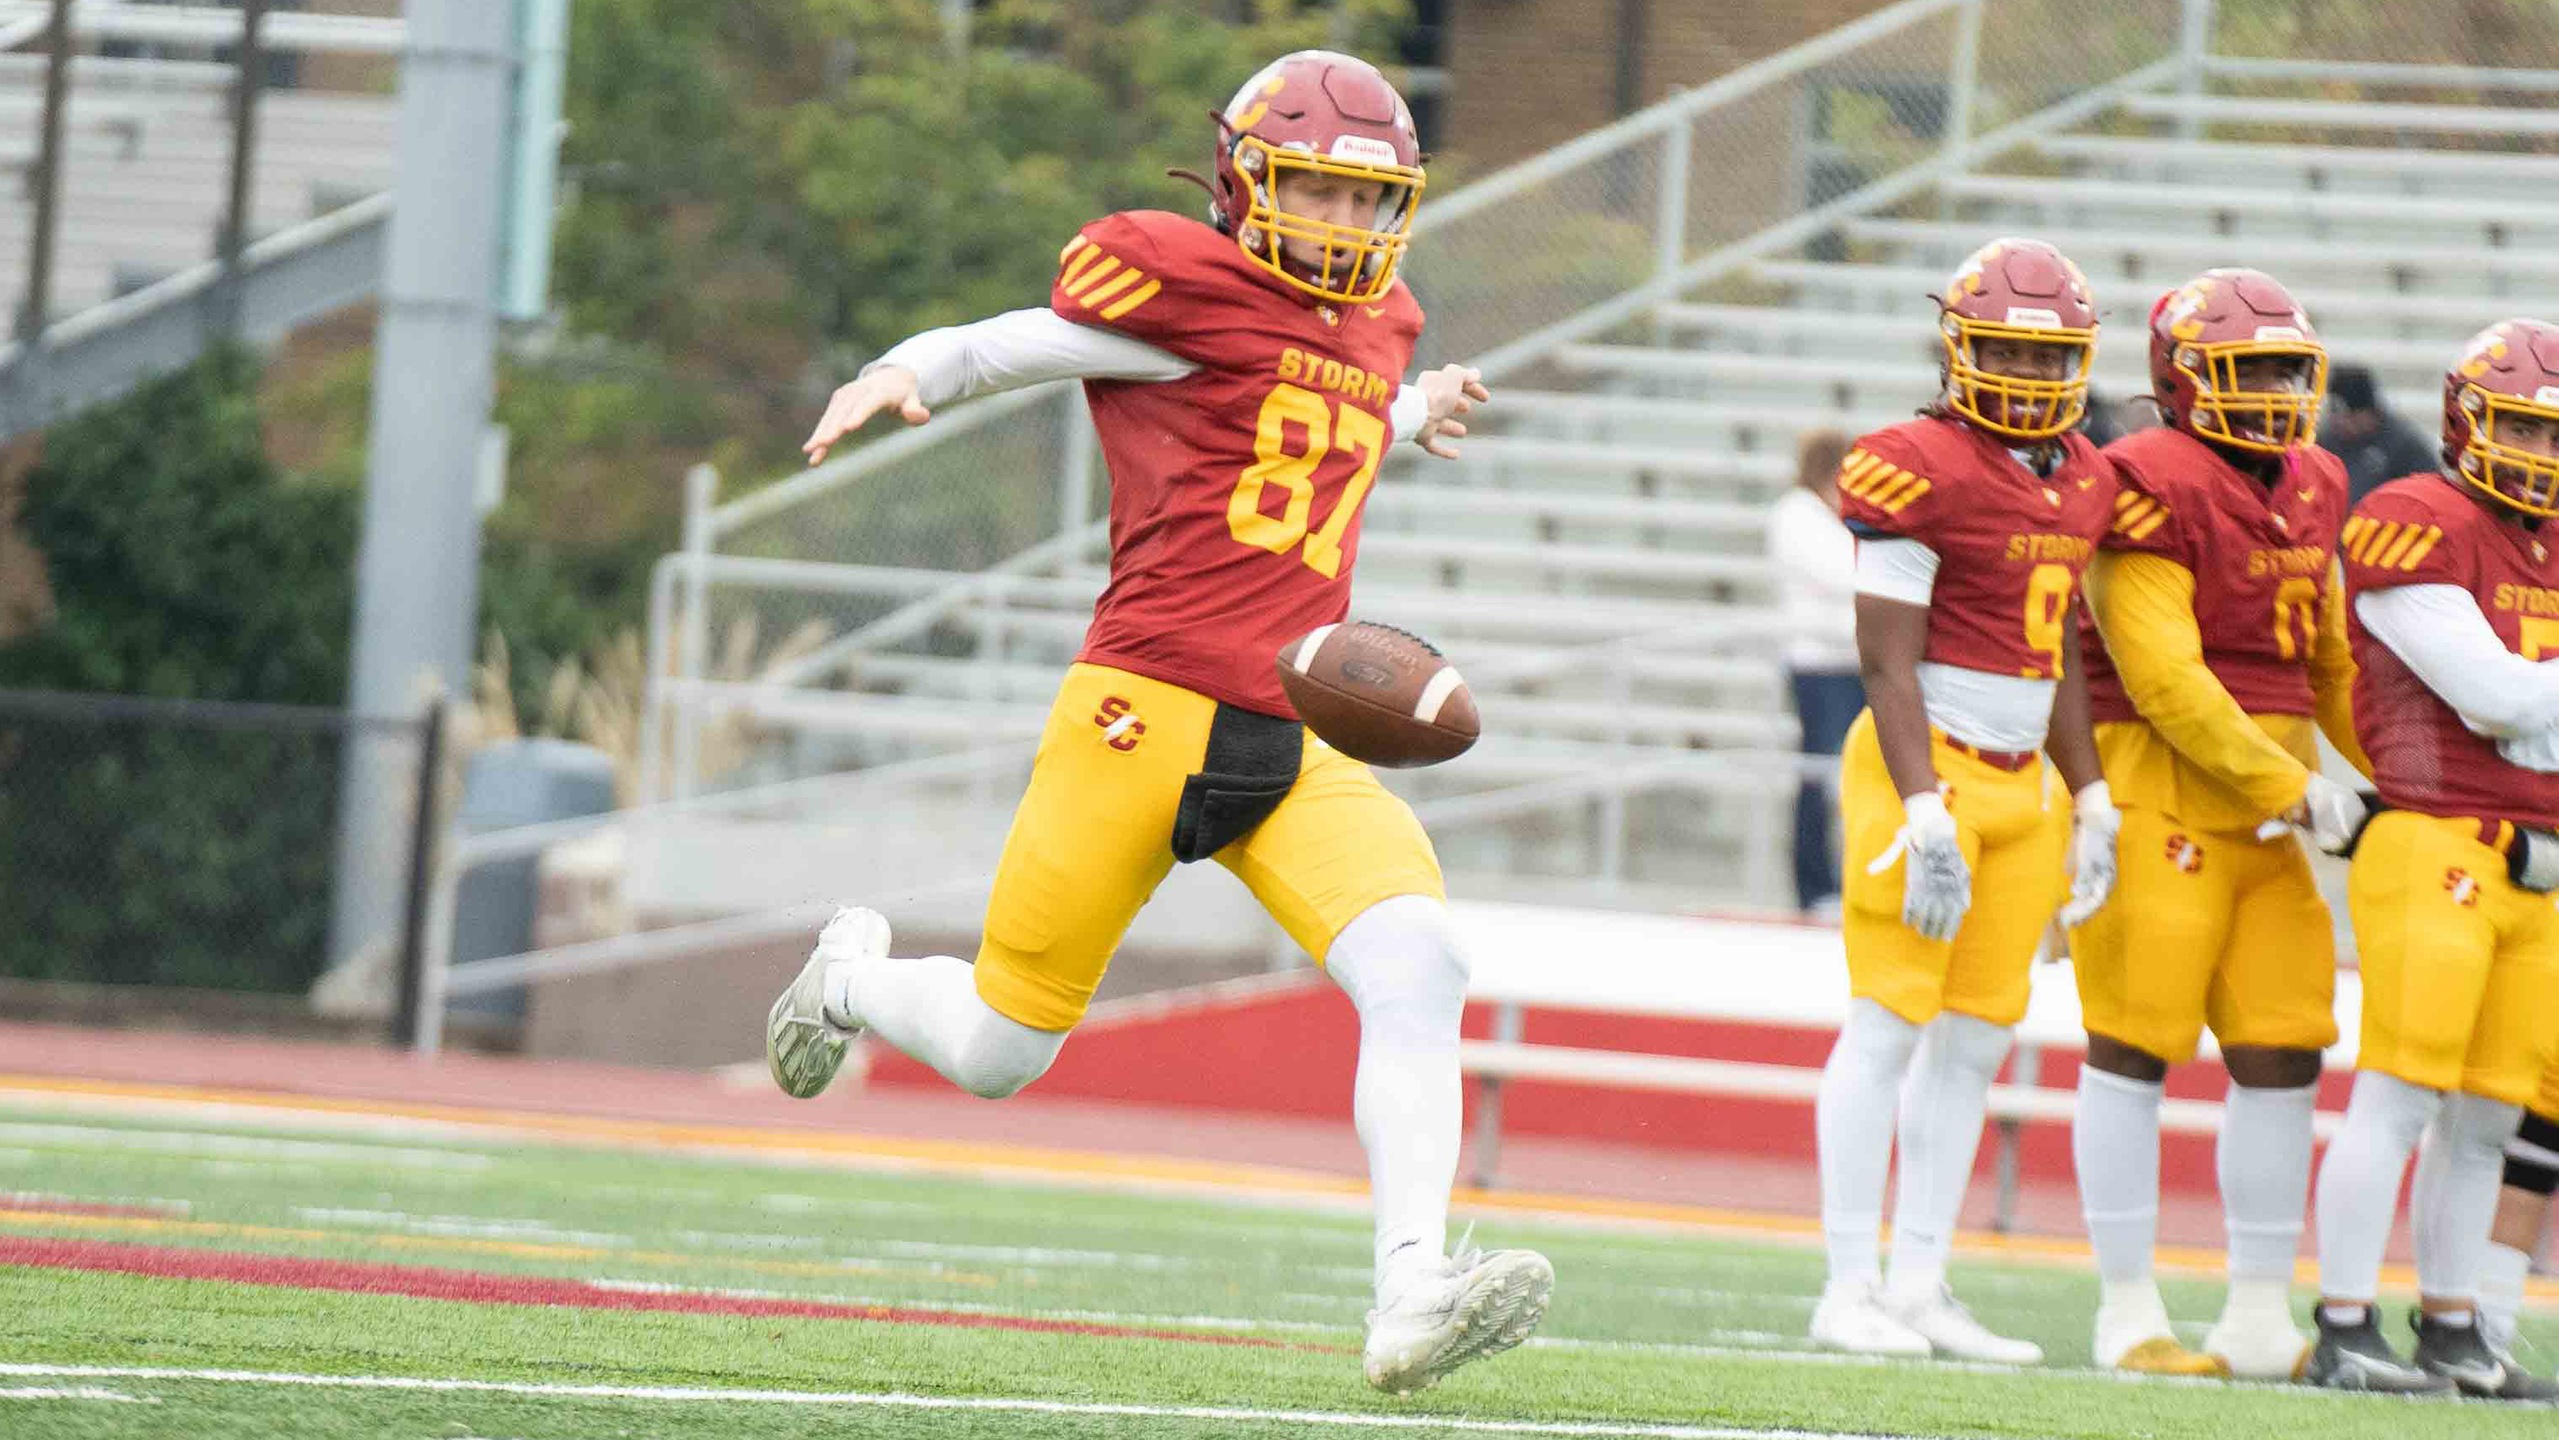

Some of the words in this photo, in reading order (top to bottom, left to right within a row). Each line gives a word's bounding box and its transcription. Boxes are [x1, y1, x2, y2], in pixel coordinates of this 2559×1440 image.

[1277, 347, 1388, 407] STORM
[1227, 382, 1387, 579] 87
[2005, 533, 2091, 560] STORM
[2020, 564, 2072, 679] 9
